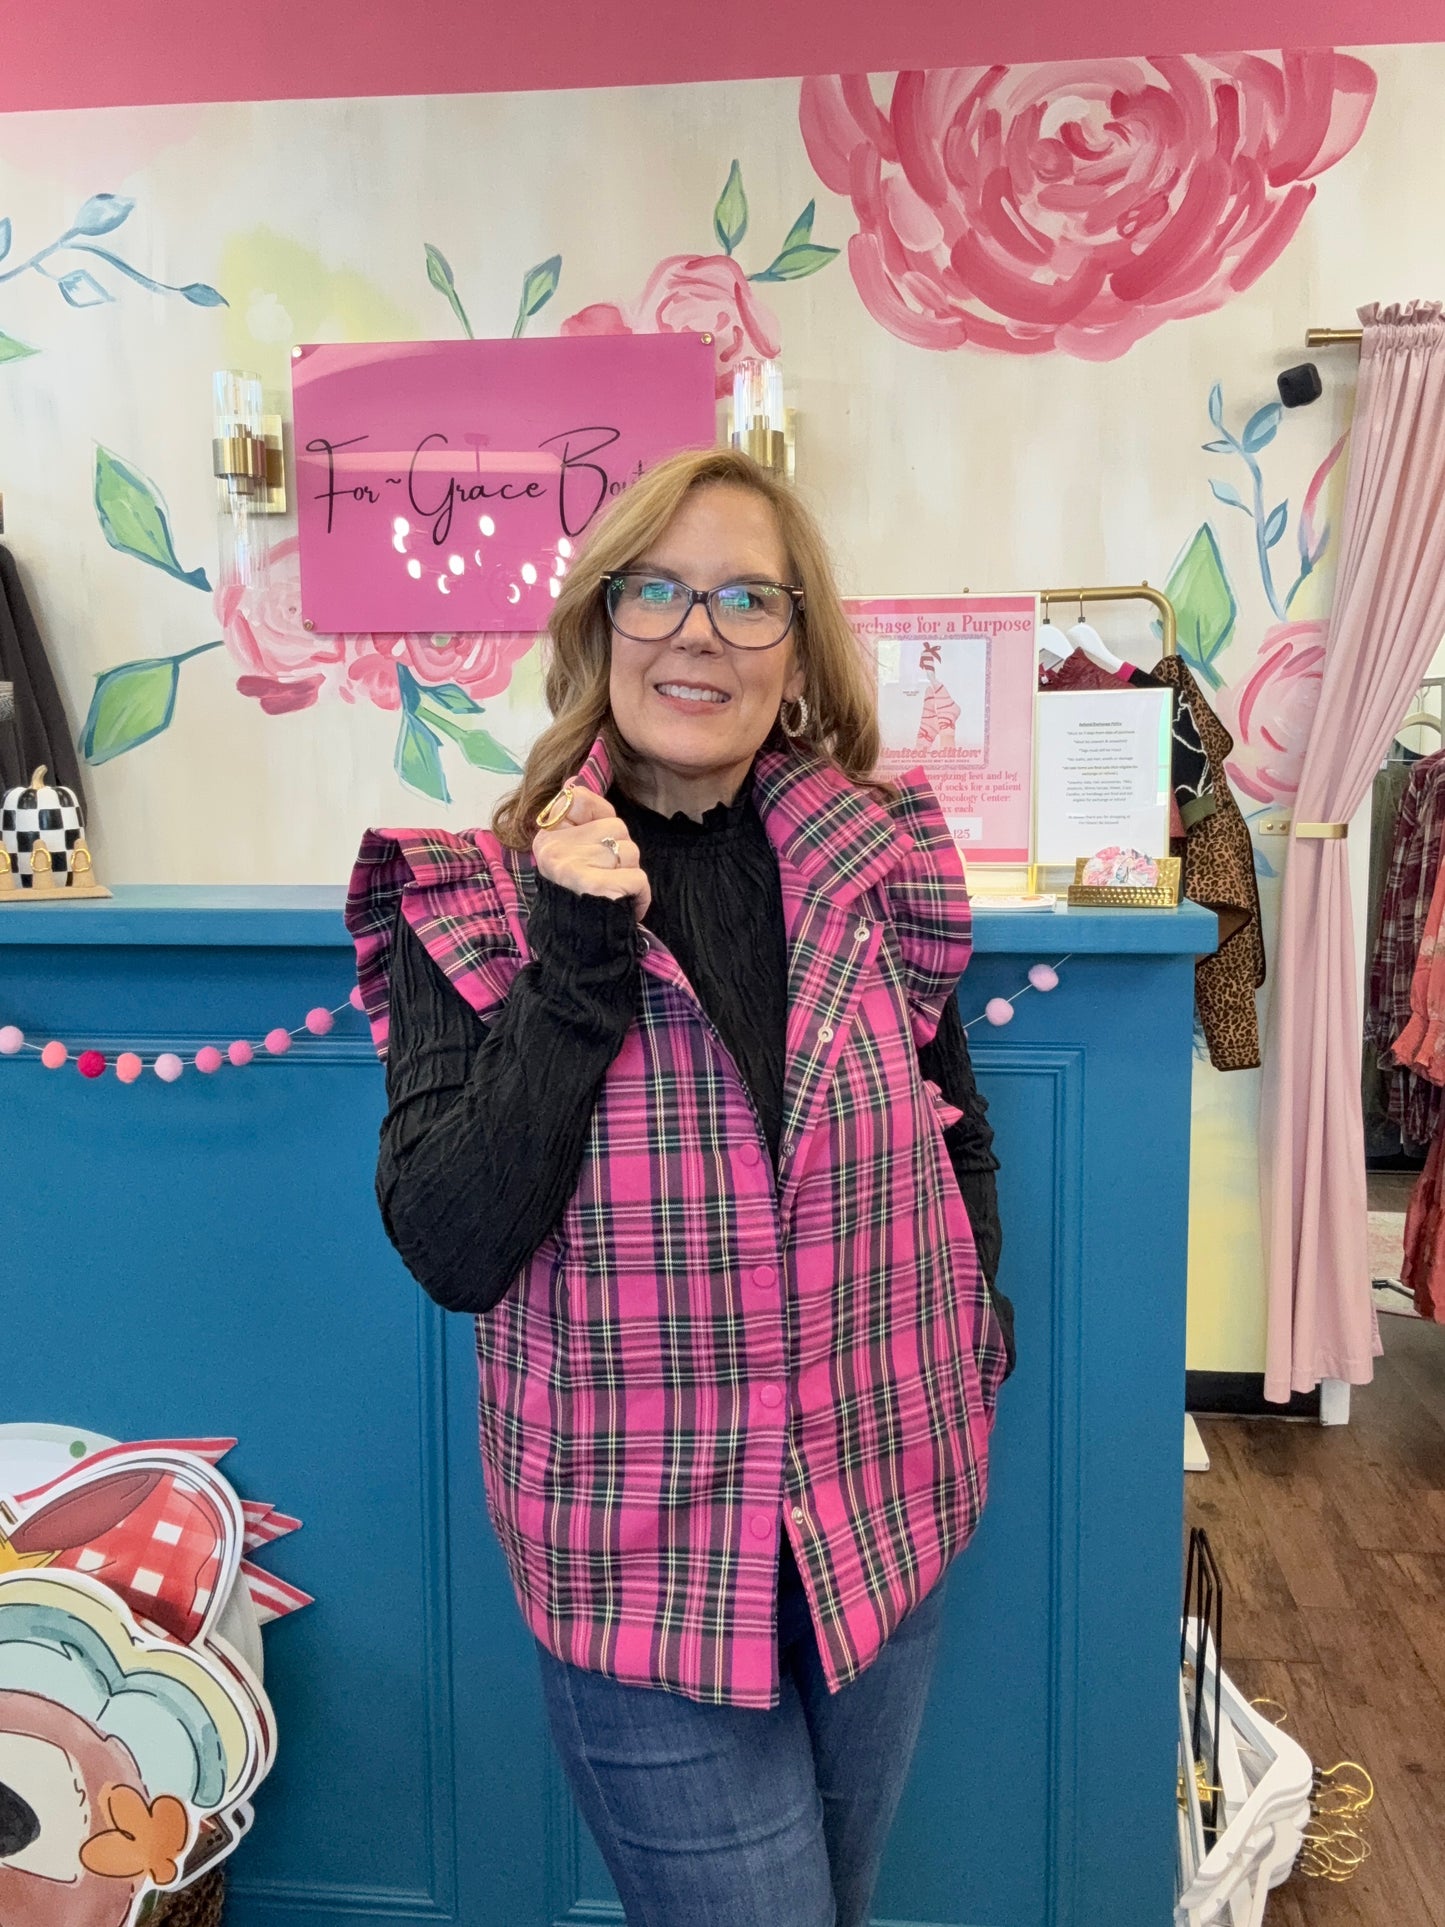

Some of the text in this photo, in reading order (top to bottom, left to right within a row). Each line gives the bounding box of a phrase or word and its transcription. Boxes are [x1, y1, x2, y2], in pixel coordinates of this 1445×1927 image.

[917, 616, 941, 633] for
[946, 620, 956, 632] a
[962, 615, 1032, 636] Purpose
[986, 771, 1002, 780] and
[1005, 771, 1018, 782] leg
[935, 783, 943, 791] of
[946, 782, 968, 791] socks
[971, 782, 983, 791] for
[993, 783, 1021, 793] patient
[939, 793, 978, 804] Oncology
[955, 804, 974, 813] each
